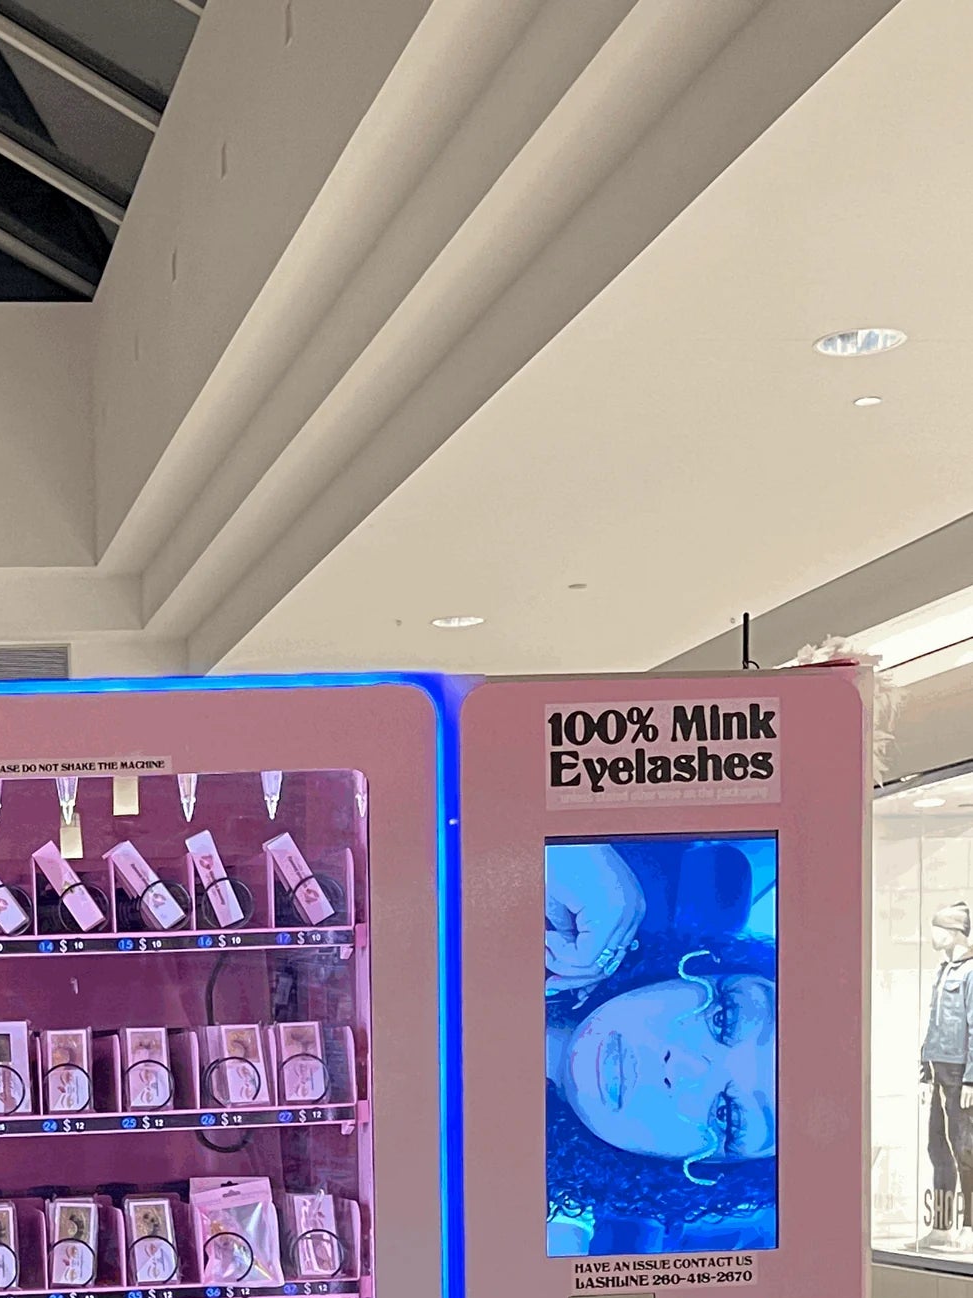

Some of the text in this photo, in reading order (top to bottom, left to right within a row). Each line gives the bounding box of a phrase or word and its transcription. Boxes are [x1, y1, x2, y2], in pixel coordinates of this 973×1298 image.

[548, 706, 658, 746] 100%
[22, 764, 36, 773] DO
[39, 763, 59, 772] NOT
[61, 762, 96, 772] SHAKE
[98, 762, 118, 771] THE
[120, 760, 165, 769] MACHINE
[550, 746, 774, 793] Eyelashes
[218, 934, 226, 948] $
[232, 937, 241, 945] 10
[63, 1118, 71, 1132] $
[75, 1122, 85, 1130] 12
[142, 1115, 150, 1129] $
[221, 1113, 229, 1126] $
[923, 1188, 966, 1231] SHOP
[575, 1255, 753, 1274] HAVE AN ISSUE CONTACT US
[575, 1270, 753, 1289] LASHLINE 260-418-2670
[226, 1286, 234, 1298] $
[241, 1288, 250, 1296] 12
